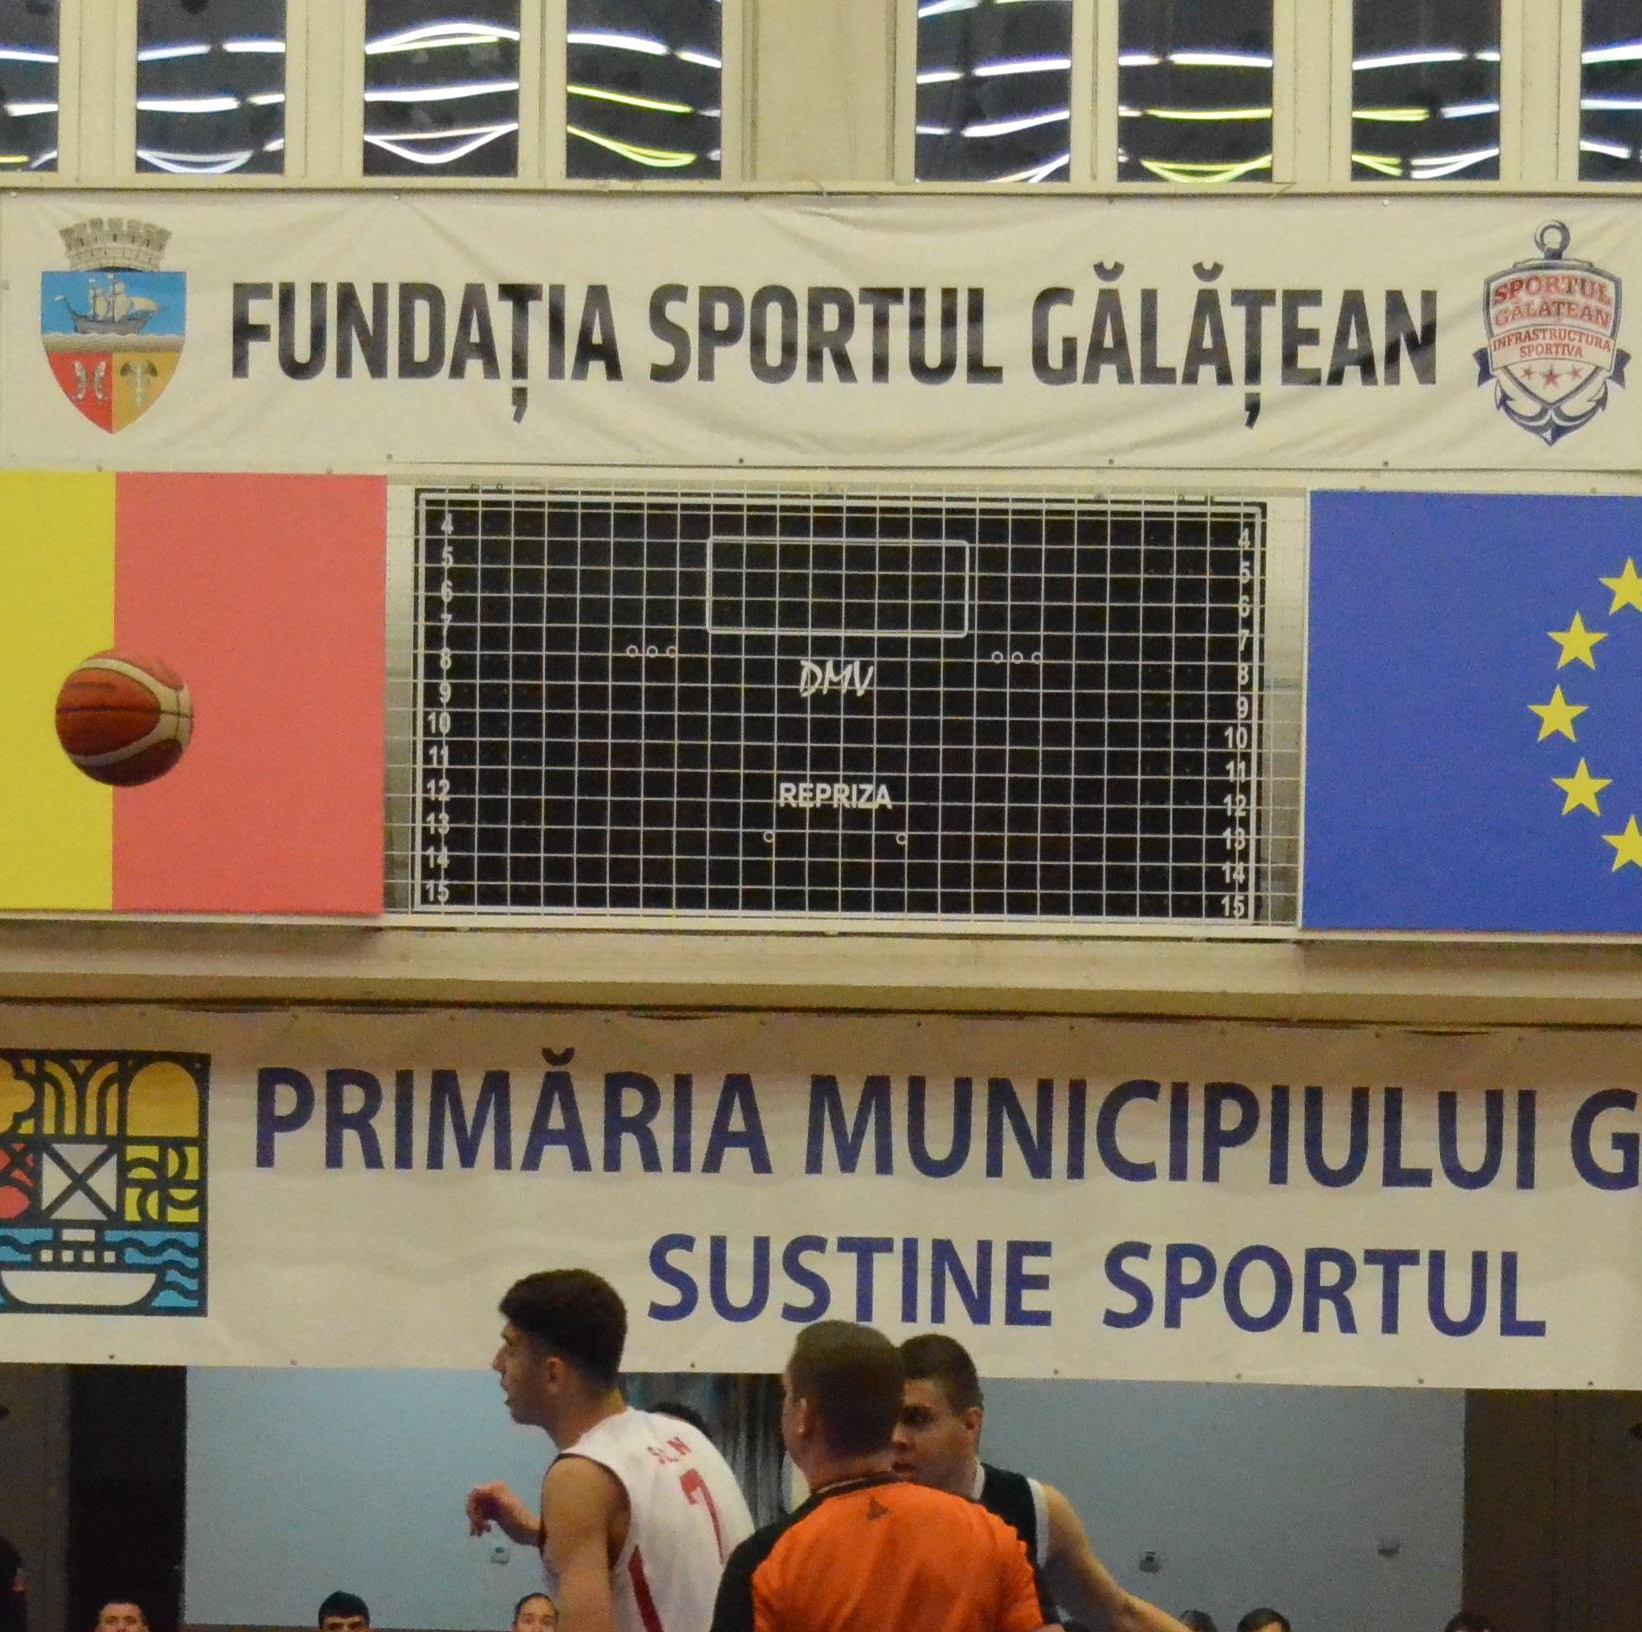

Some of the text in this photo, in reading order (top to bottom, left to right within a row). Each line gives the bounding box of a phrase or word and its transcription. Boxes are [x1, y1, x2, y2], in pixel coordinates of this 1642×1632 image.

[1493, 275, 1612, 305] SPORTUL
[230, 261, 1439, 428] FUNDAȚIA SPORTUL GĂLĂȚEAN
[1492, 328, 1611, 353] INFRASTRUCTURA
[1519, 343, 1583, 358] SPORTIVA
[799, 660, 875, 698] DMV
[779, 782, 893, 810] REPRIZA
[255, 1047, 773, 1175] PRIMĂRIA
[804, 1074, 1537, 1191] MUNICIPIULUI
[648, 1233, 1546, 1338] SUSTINE SPORTUL
